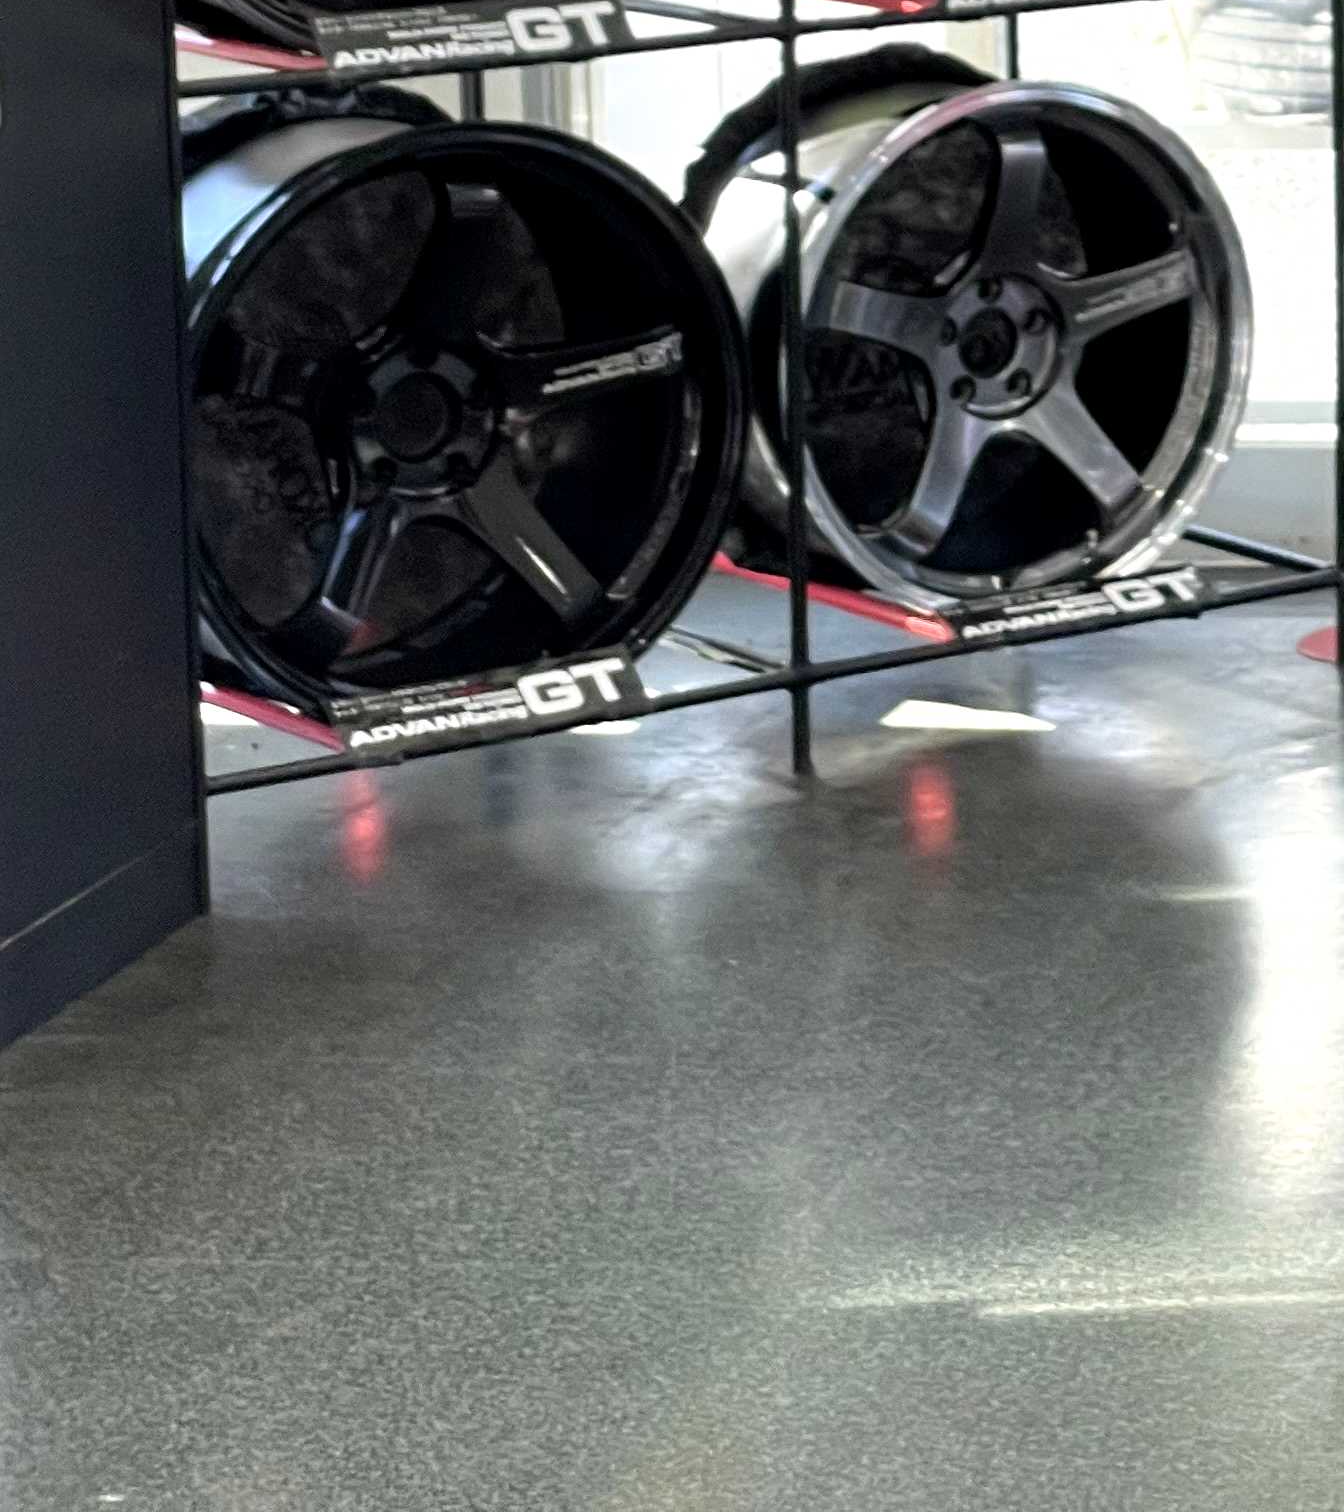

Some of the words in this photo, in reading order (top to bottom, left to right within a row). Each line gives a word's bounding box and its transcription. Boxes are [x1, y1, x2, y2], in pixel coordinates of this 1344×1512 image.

[334, 41, 449, 69] ADVAN
[505, 0, 613, 53] GT
[962, 611, 1057, 640] ADVAN
[1102, 570, 1197, 614] GT
[349, 713, 462, 748] ADVAN
[517, 656, 625, 716] GT
